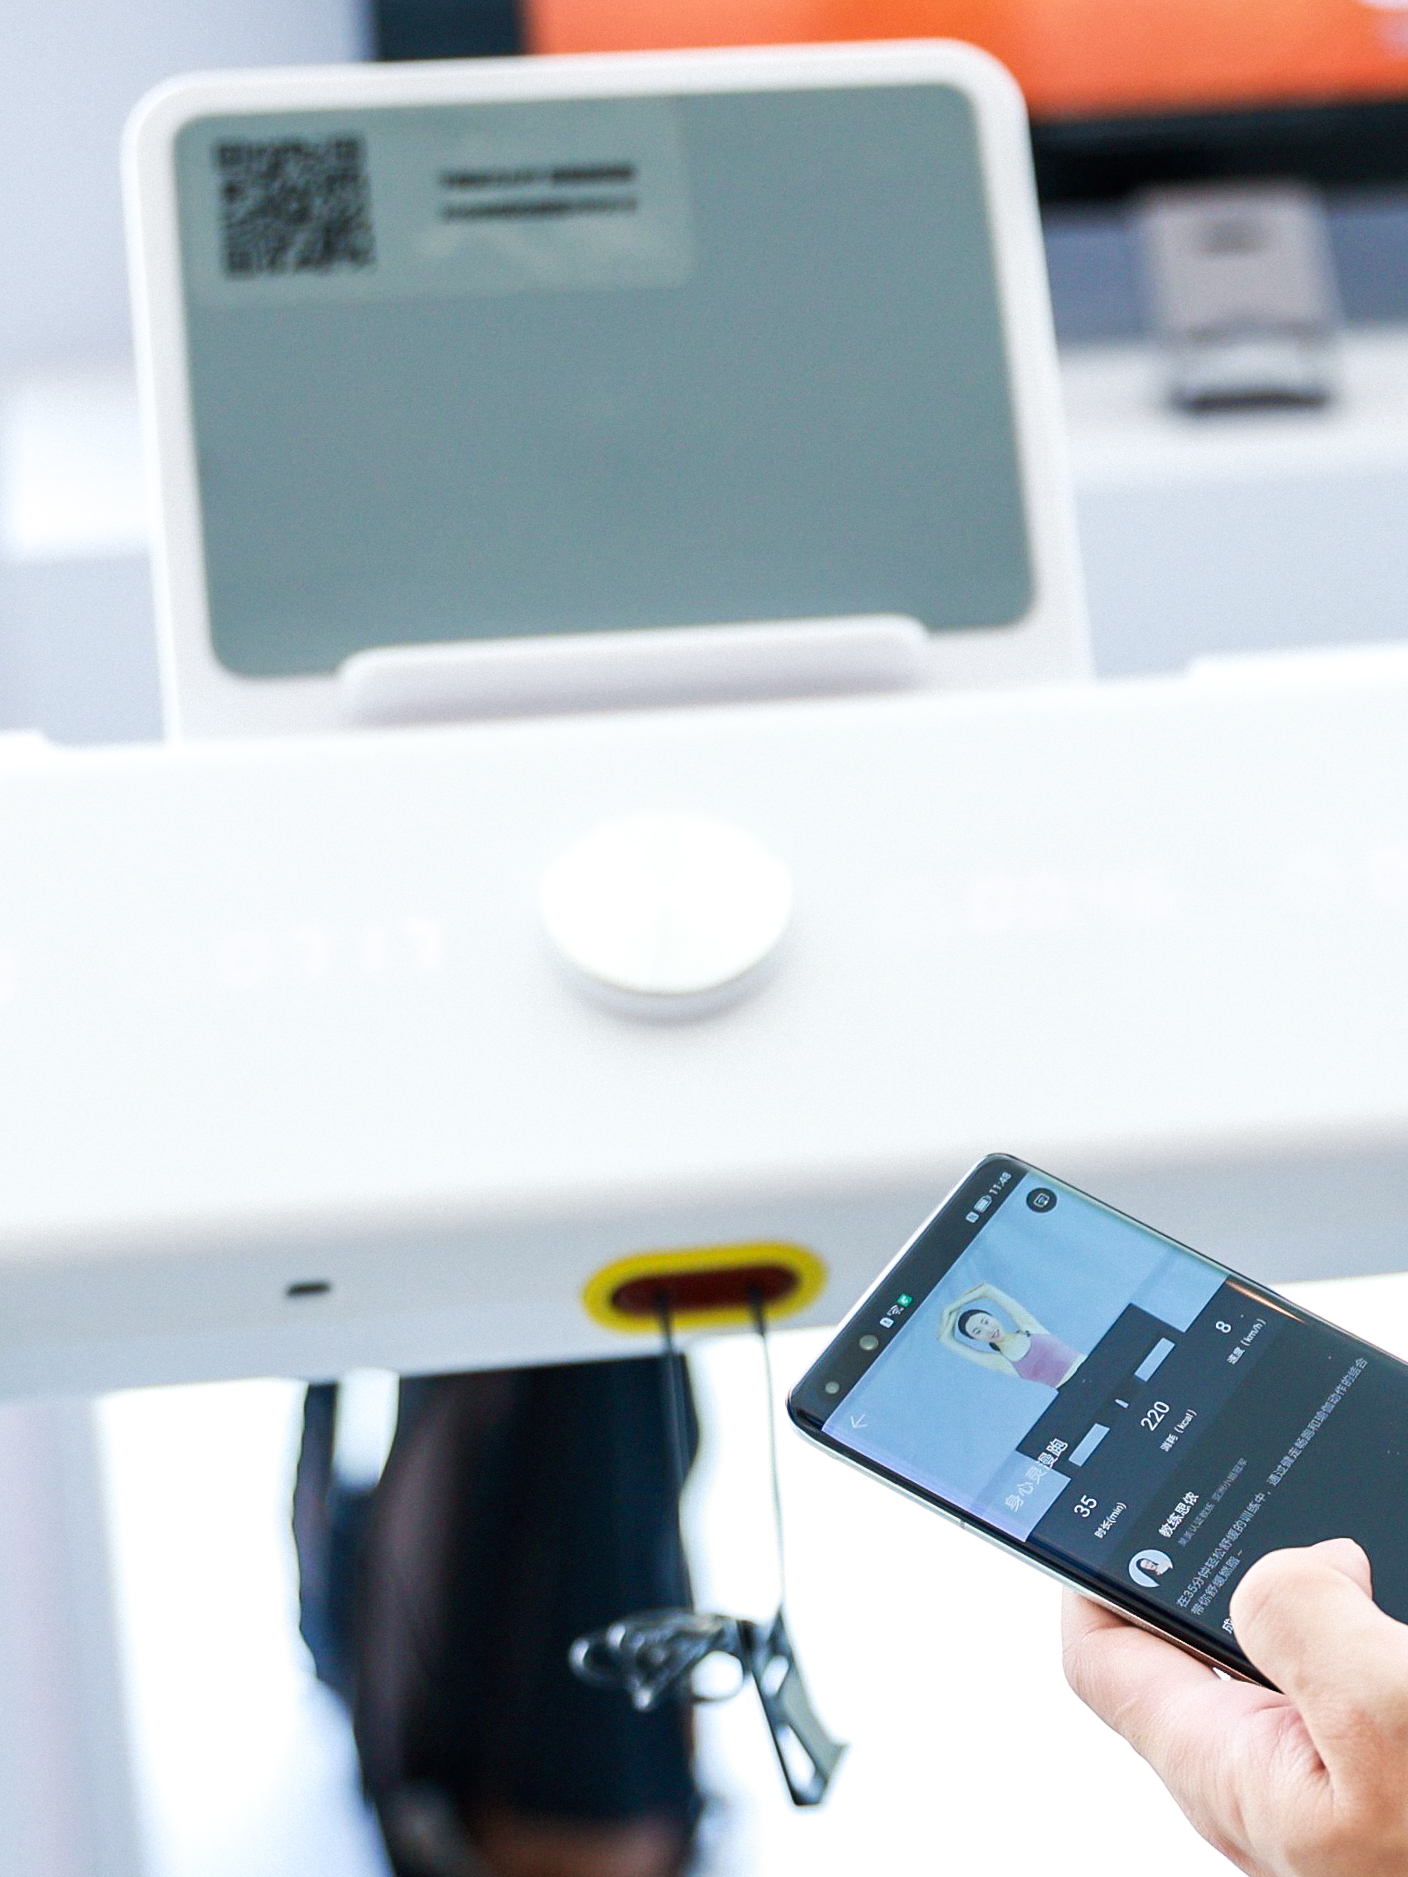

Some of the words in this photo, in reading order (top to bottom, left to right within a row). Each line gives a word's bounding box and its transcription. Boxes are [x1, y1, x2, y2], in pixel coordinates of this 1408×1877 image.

[1213, 1319, 1233, 1334] 8
[1138, 1399, 1171, 1431] 220
[1001, 1436, 1069, 1512] 身心灵漫跑
[1071, 1493, 1099, 1518] 35
